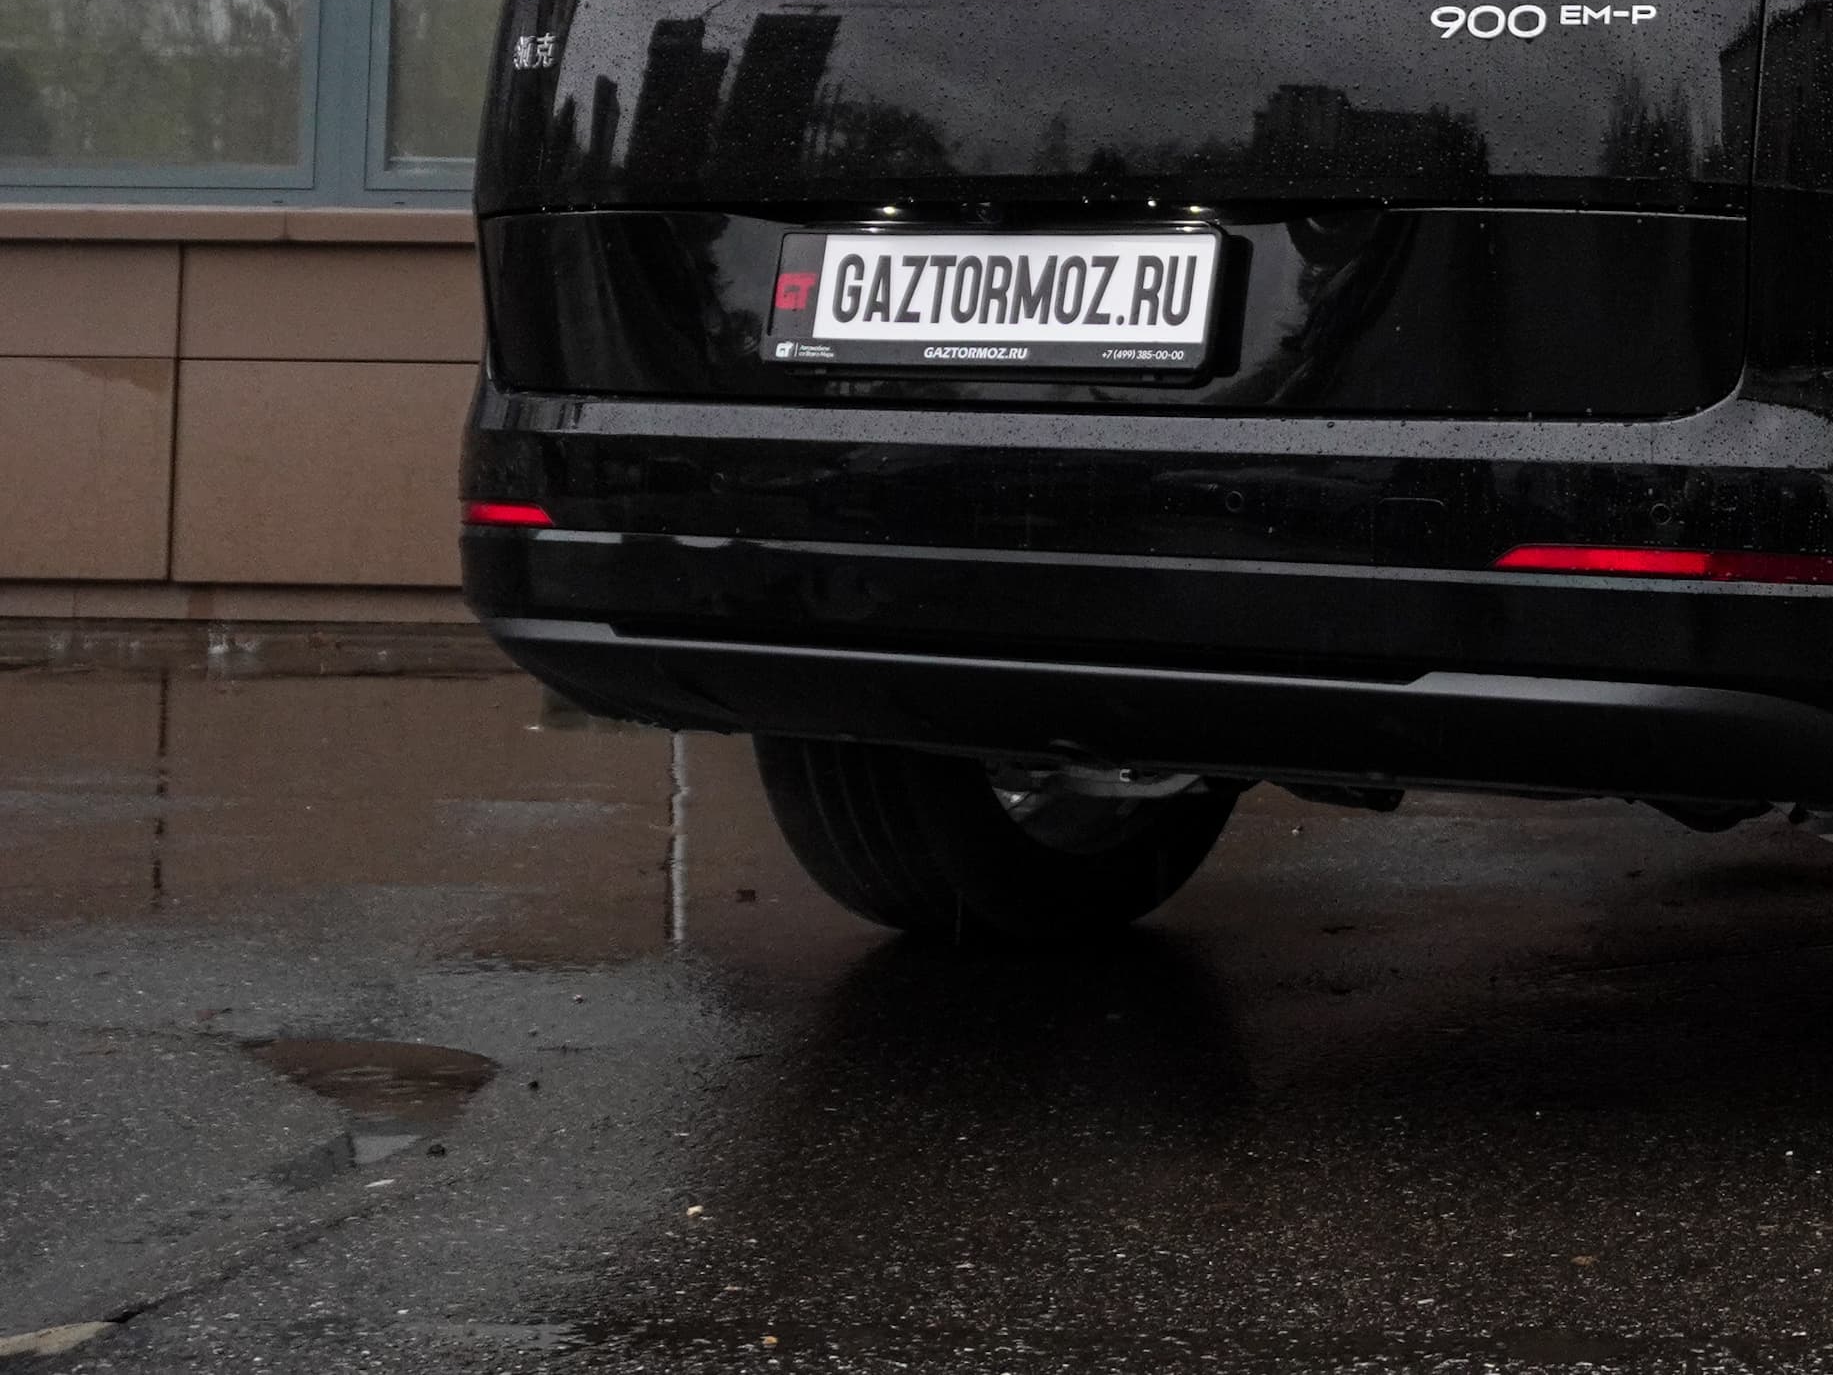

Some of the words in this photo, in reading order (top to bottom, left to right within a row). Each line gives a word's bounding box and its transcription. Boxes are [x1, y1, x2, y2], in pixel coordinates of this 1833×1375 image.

[1430, 4, 1548, 39] 900
[1559, 4, 1658, 25] EM-P
[832, 253, 1198, 327] GAZTORMOZ.RU
[923, 346, 1029, 360] GAZTORMOZ.RU
